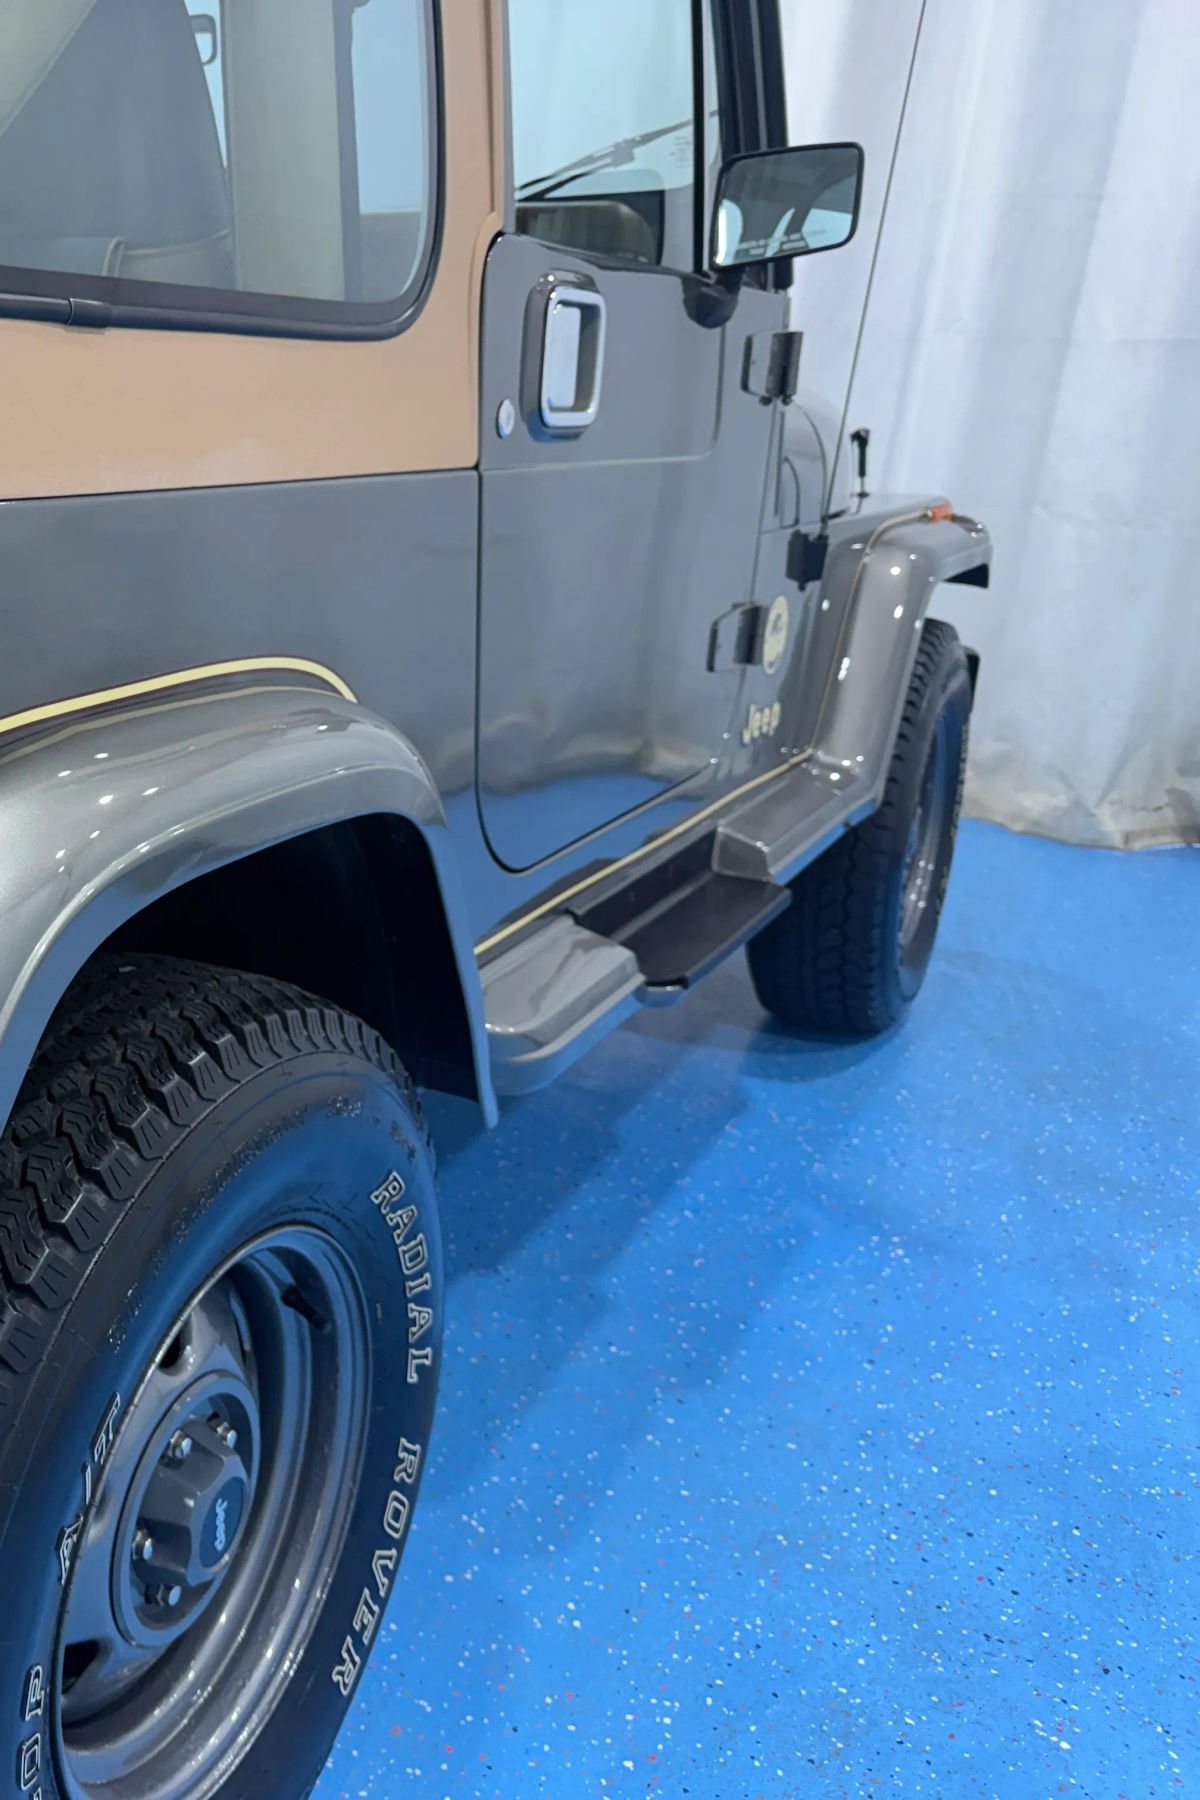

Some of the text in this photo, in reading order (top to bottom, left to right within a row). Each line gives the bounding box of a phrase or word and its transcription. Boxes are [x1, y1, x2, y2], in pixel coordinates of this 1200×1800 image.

[742, 701, 782, 744] Jeep
[331, 1169, 434, 1697] RADIAL ROVER
